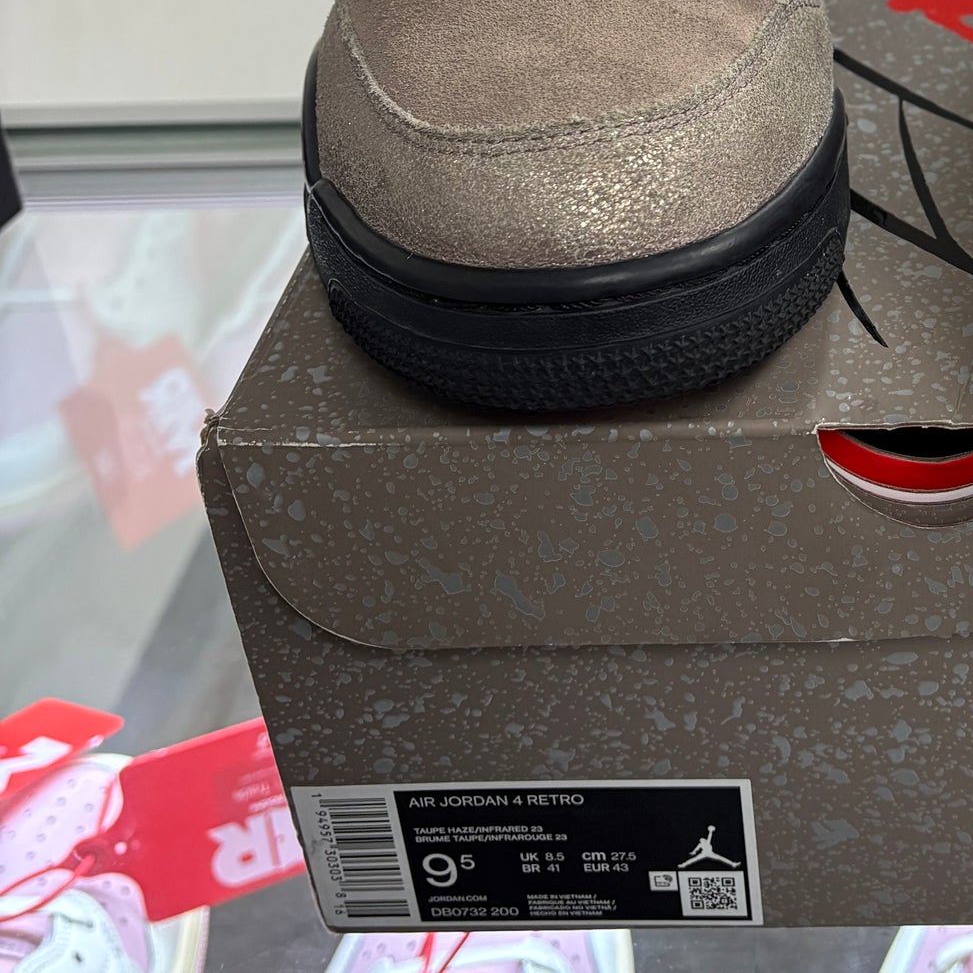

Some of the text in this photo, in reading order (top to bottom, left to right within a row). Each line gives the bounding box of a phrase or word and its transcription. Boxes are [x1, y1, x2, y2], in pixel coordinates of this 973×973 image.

[409, 794, 584, 808] AIR JORDAN 4 RETRO
[413, 825, 543, 835] TAUPE HAZE/INFRARED 23
[415, 835, 450, 843] BRUME
[453, 834, 553, 842] TAUPE/INFRAROUGE
[315, 810, 333, 844] 94957
[325, 849, 342, 882] 30303
[520, 852, 565, 861] UK 8.5
[582, 852, 636, 861] cm 27.5
[522, 864, 560, 873] BR 41
[584, 863, 629, 872] EUR 43
[431, 907, 519, 917] DB0732 200
